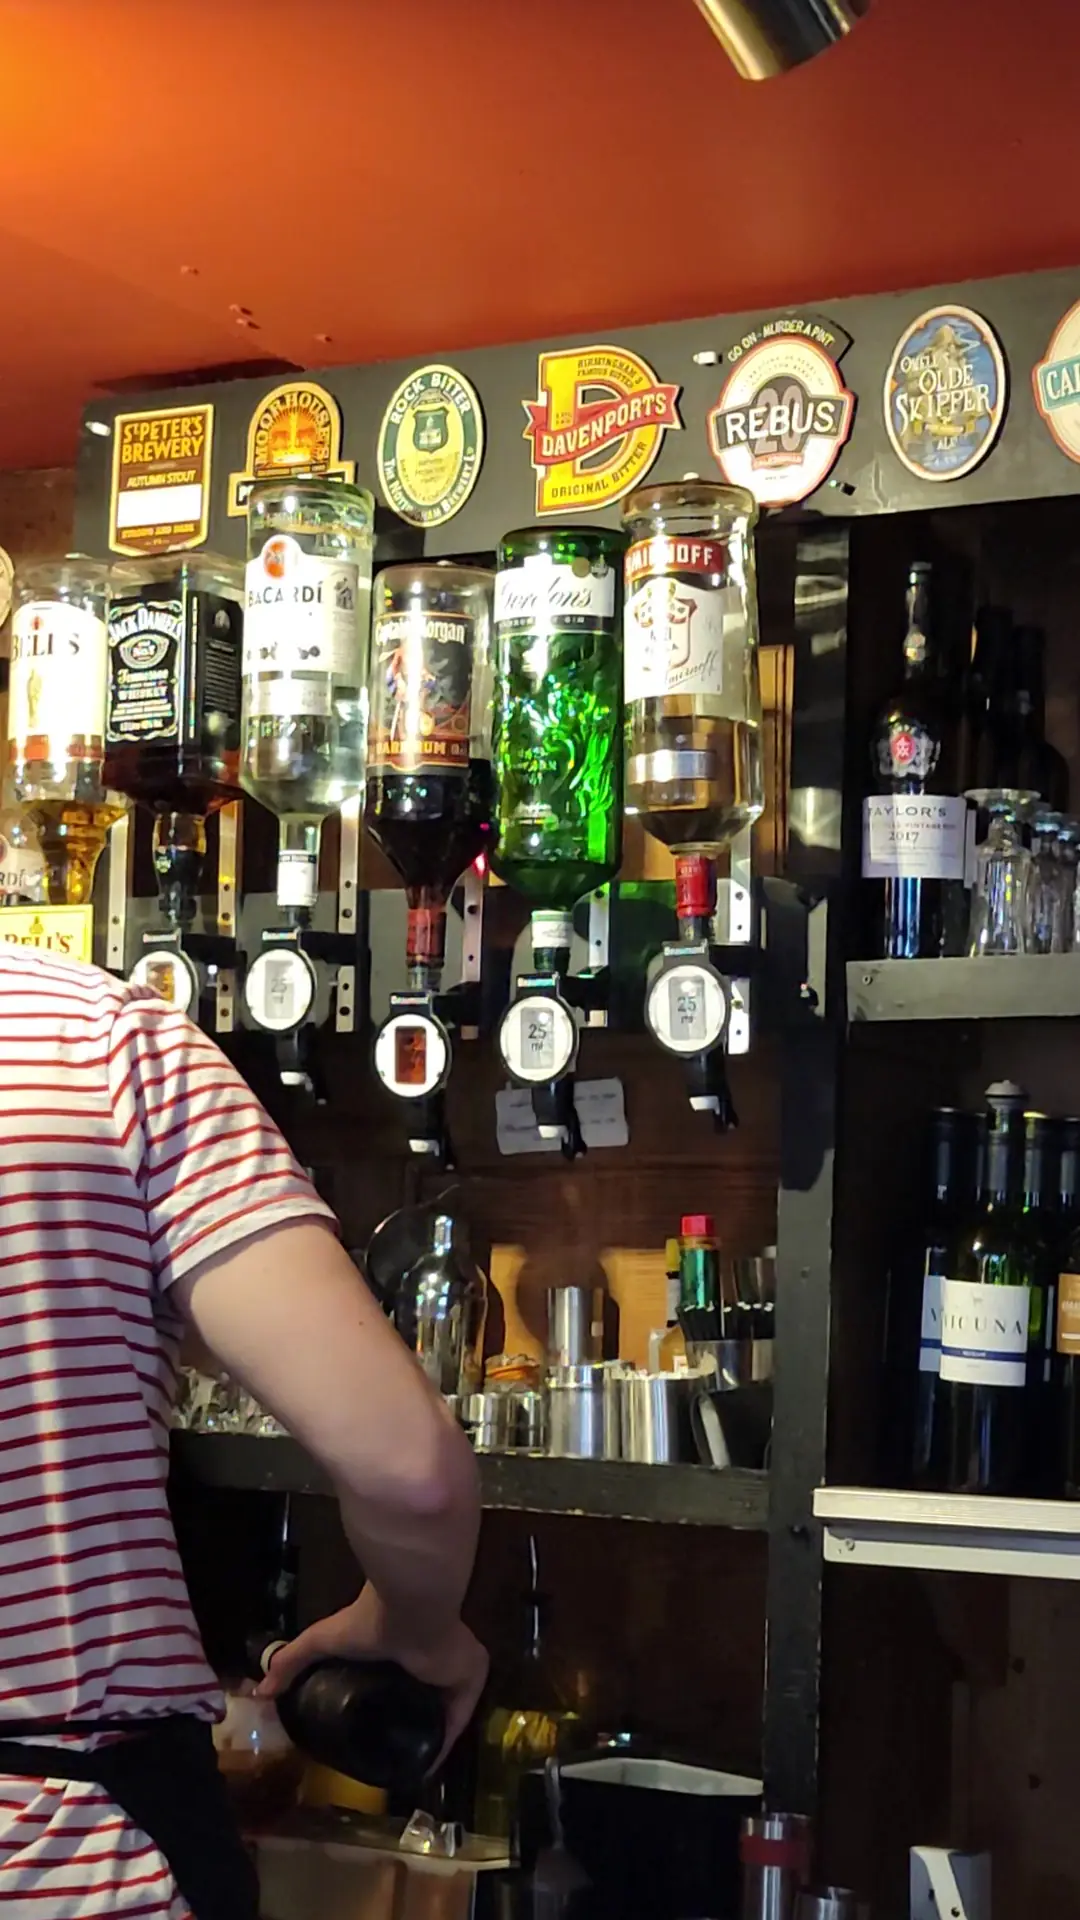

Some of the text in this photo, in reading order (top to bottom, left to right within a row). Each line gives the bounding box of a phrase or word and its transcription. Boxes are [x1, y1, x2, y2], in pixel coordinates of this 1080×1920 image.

[727, 346, 743, 362] GO
[741, 332, 757, 349] ON
[763, 320, 804, 338] MURDER
[919, 363, 974, 395] OLDE
[390, 372, 471, 425] ROCK BITTER
[895, 383, 993, 437] SKIPPER
[541, 393, 667, 457] DAVENPORTS
[726, 401, 836, 445] REBUS
[121, 436, 204, 464] BREWERY
[165, 469, 197, 484] STOUT
[551, 441, 647, 498] ORIGINAL BITTER
[624, 543, 713, 578] SMIOFF
[414, 616, 466, 645] organ
[11, 632, 80, 662] BELLS
[867, 806, 947, 818] TAYLOR'S
[888, 831, 920, 846] 2017
[270, 978, 288, 994] 25
[677, 996, 697, 1013] 25
[527, 1023, 547, 1040] 25
